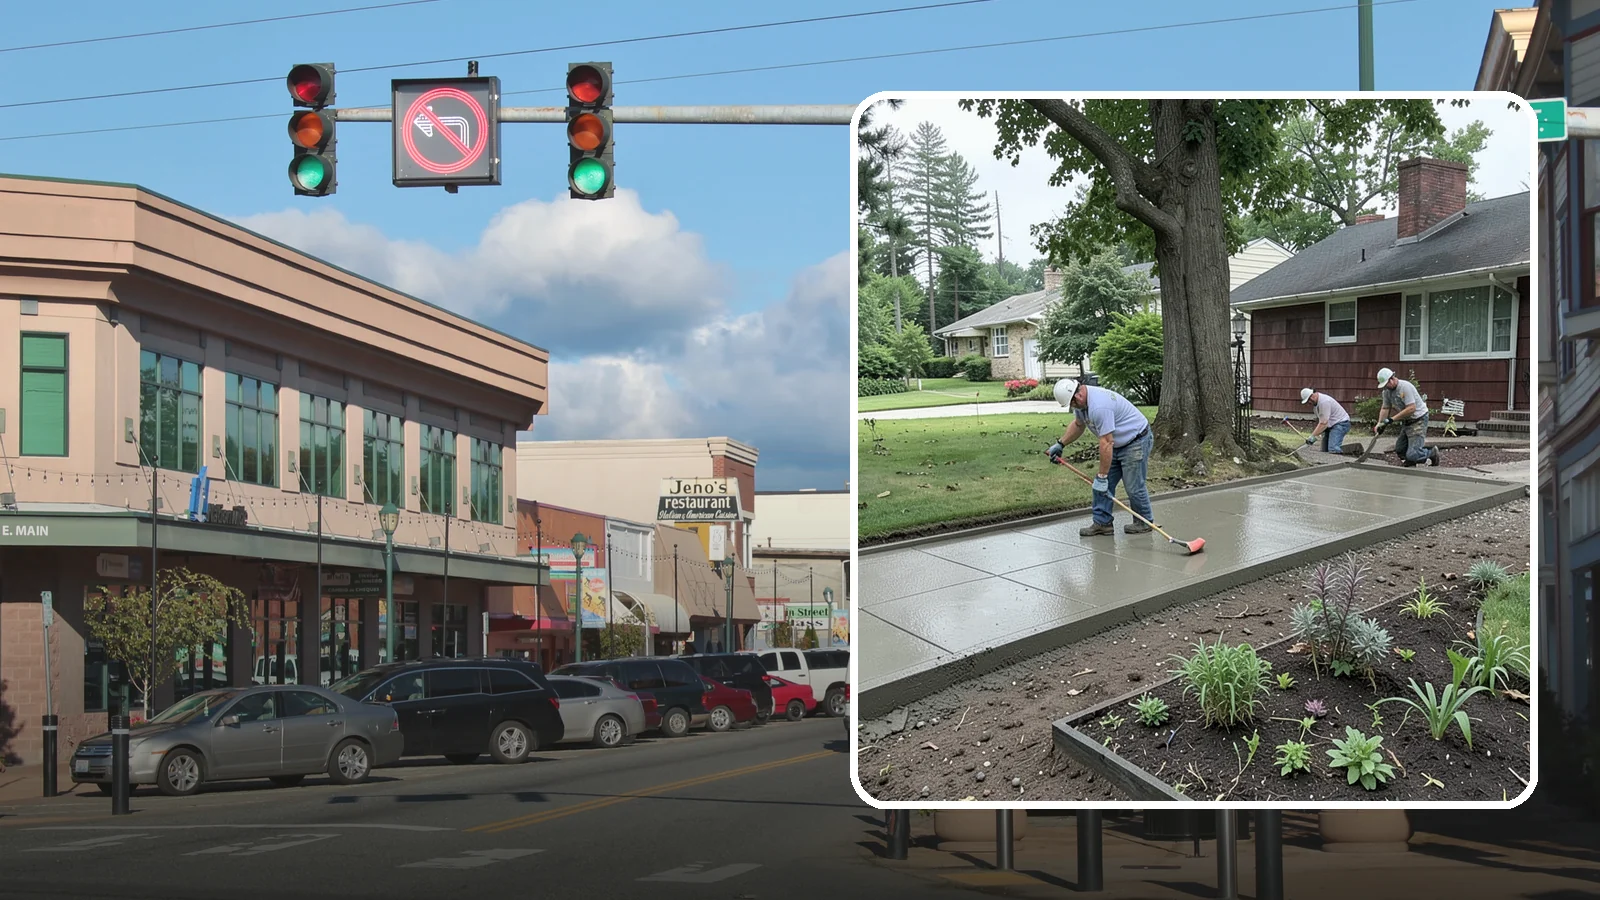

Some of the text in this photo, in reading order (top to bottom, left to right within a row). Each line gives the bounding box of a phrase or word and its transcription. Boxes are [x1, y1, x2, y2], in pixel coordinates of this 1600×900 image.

[670, 480, 727, 495] Jeno's
[665, 496, 731, 509] restaurant
[658, 510, 681, 519] Italian
[686, 509, 714, 519] American
[714, 509, 737, 519] Cuisine
[2, 525, 49, 536] E. MAIN
[797, 607, 828, 617] Street
[791, 619, 823, 627] lass
